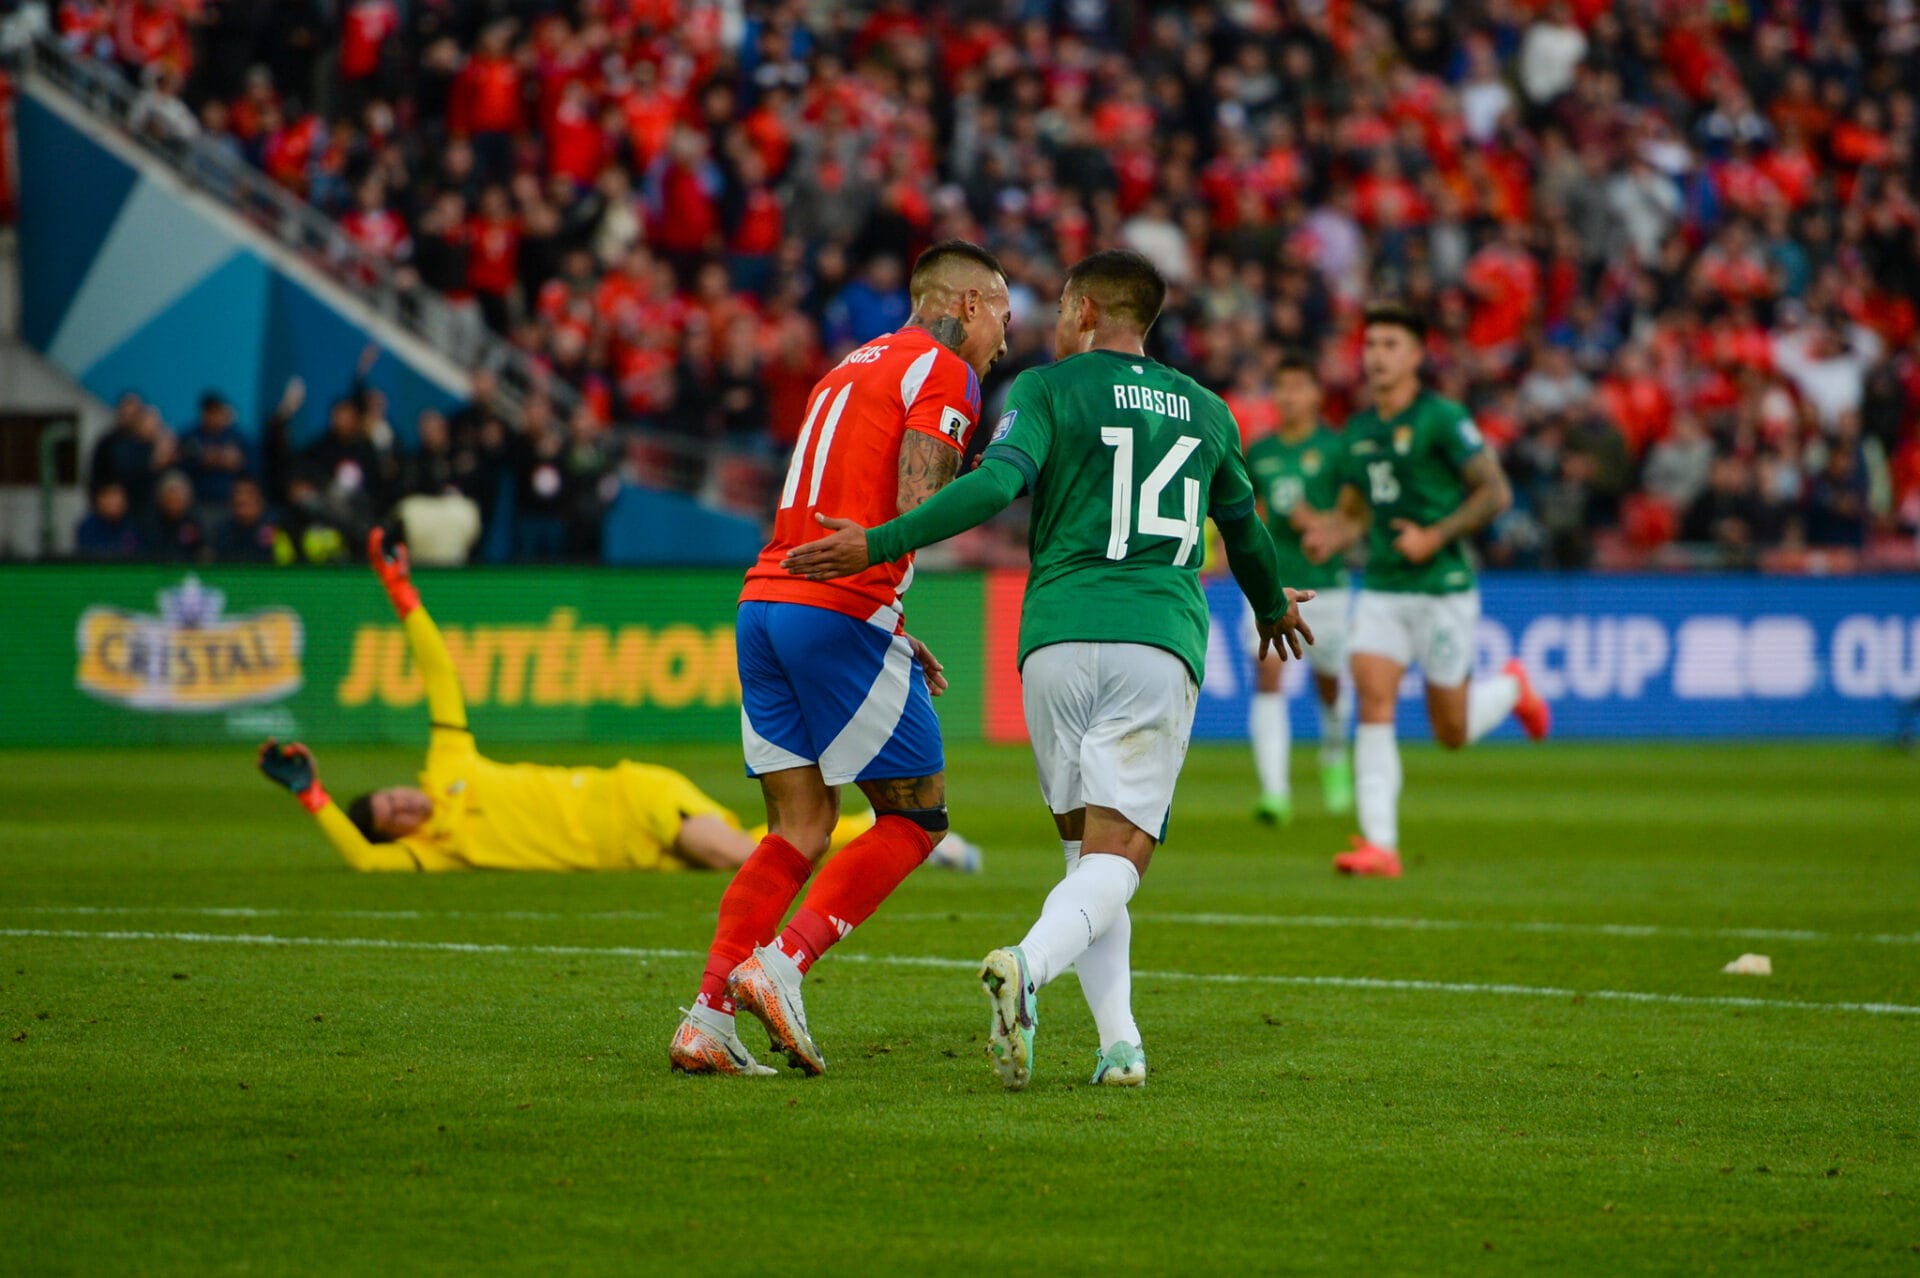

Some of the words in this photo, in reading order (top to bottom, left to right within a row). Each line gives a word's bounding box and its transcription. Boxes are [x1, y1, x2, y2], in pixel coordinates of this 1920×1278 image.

[832, 345, 890, 373] GAS
[1113, 384, 1191, 422] ROBSON
[779, 381, 854, 510] 11
[1100, 426, 1202, 567] 14
[98, 620, 280, 686] CRISTAL
[1520, 614, 1669, 699] CUP
